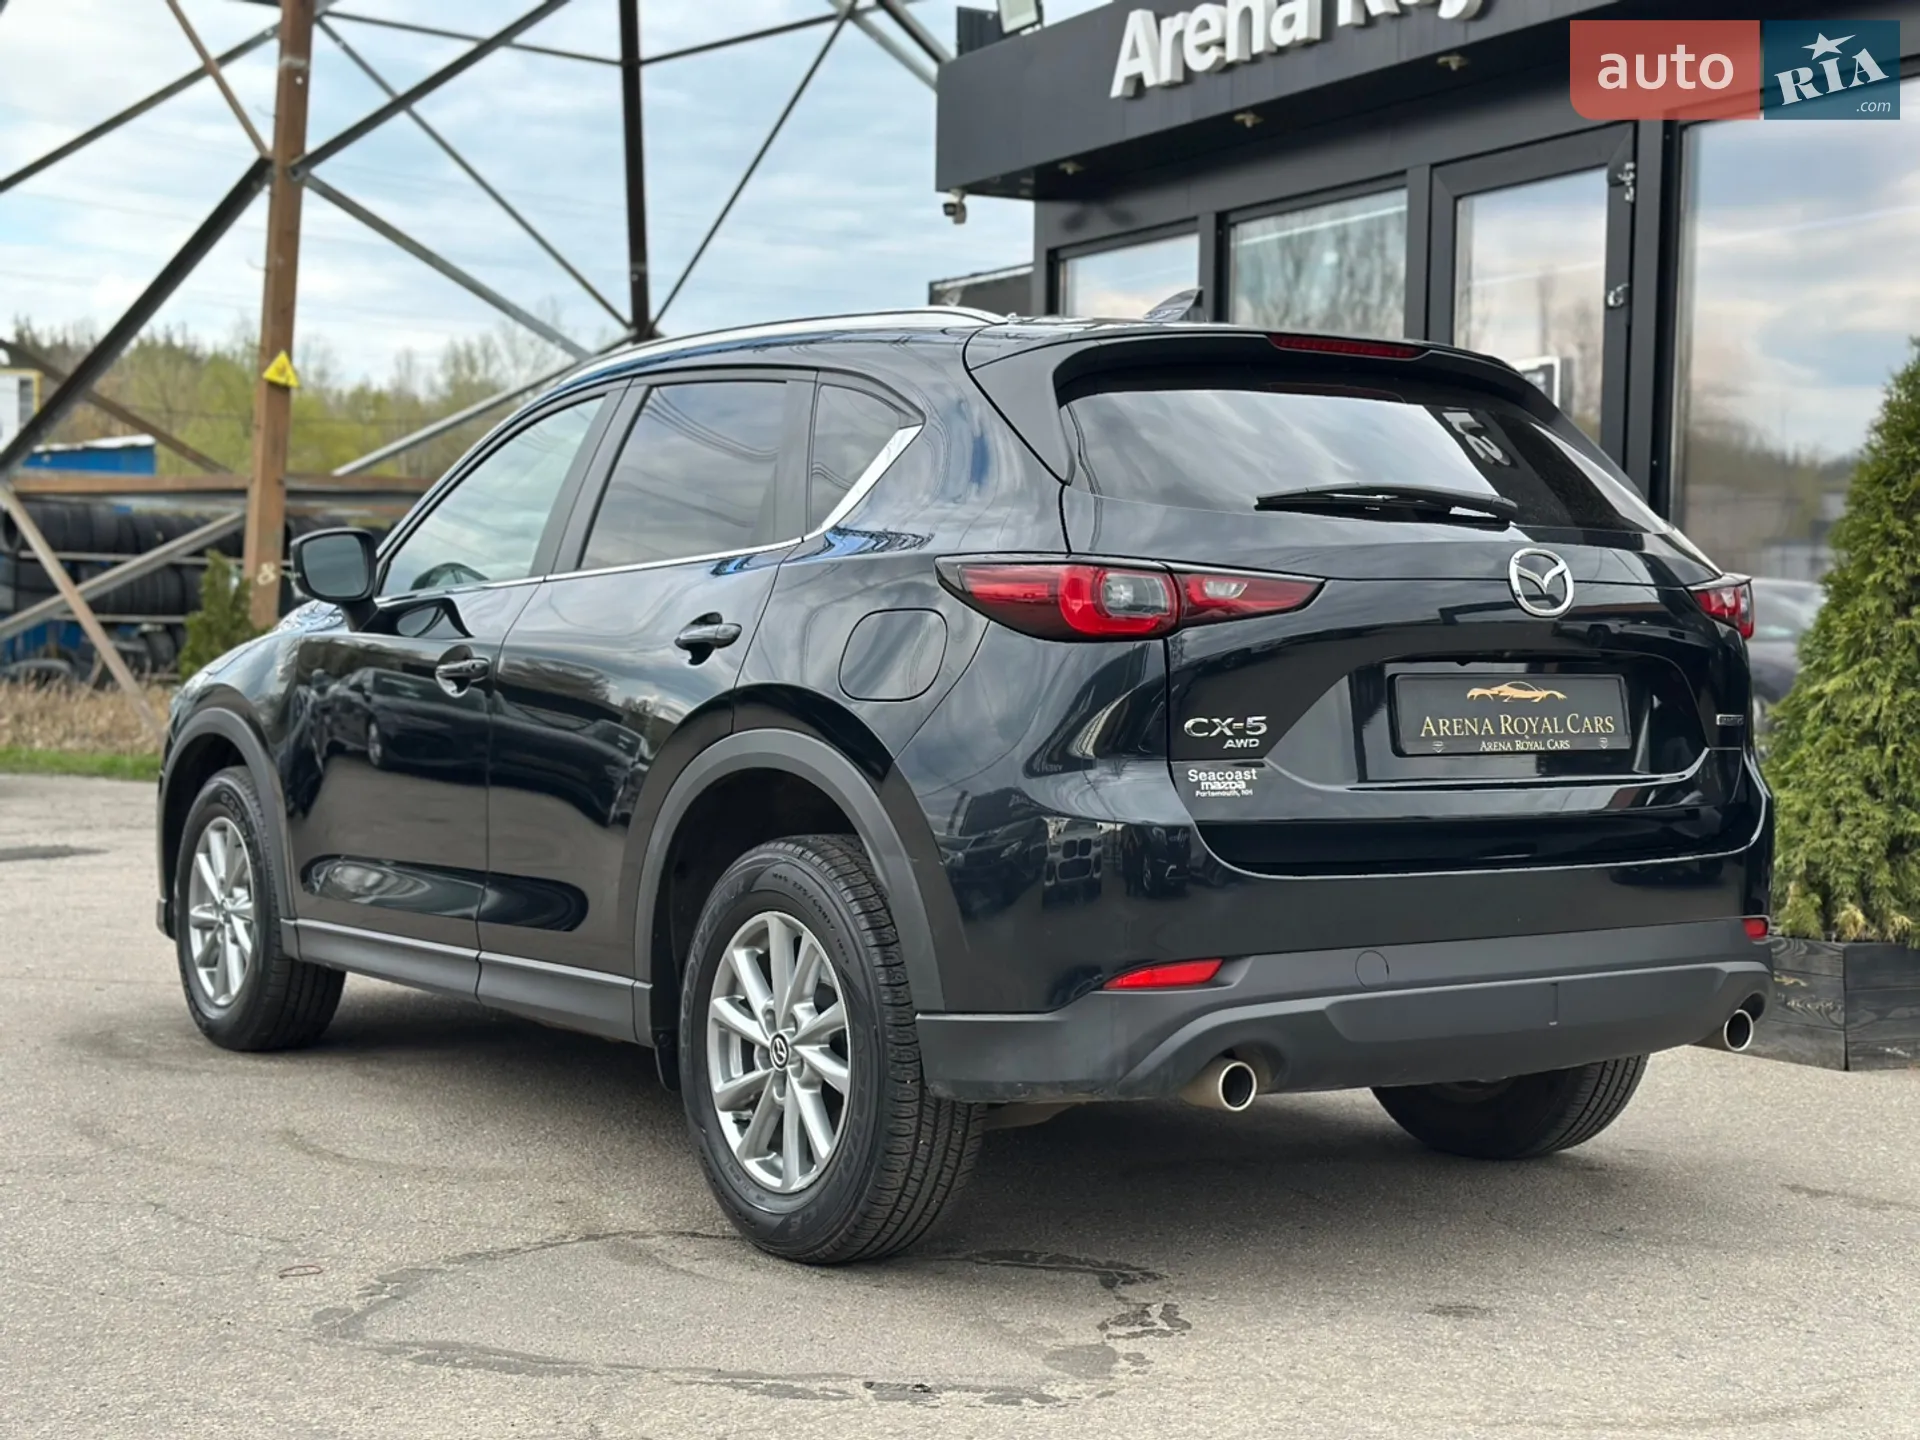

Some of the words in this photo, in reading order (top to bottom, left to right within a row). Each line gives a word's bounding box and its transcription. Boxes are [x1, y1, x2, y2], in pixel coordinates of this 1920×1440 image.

[1110, 0, 1321, 98] Arena
[1184, 716, 1267, 737] CX-5
[1223, 738, 1260, 749] AWD
[1187, 768, 1258, 782] Seacoast
